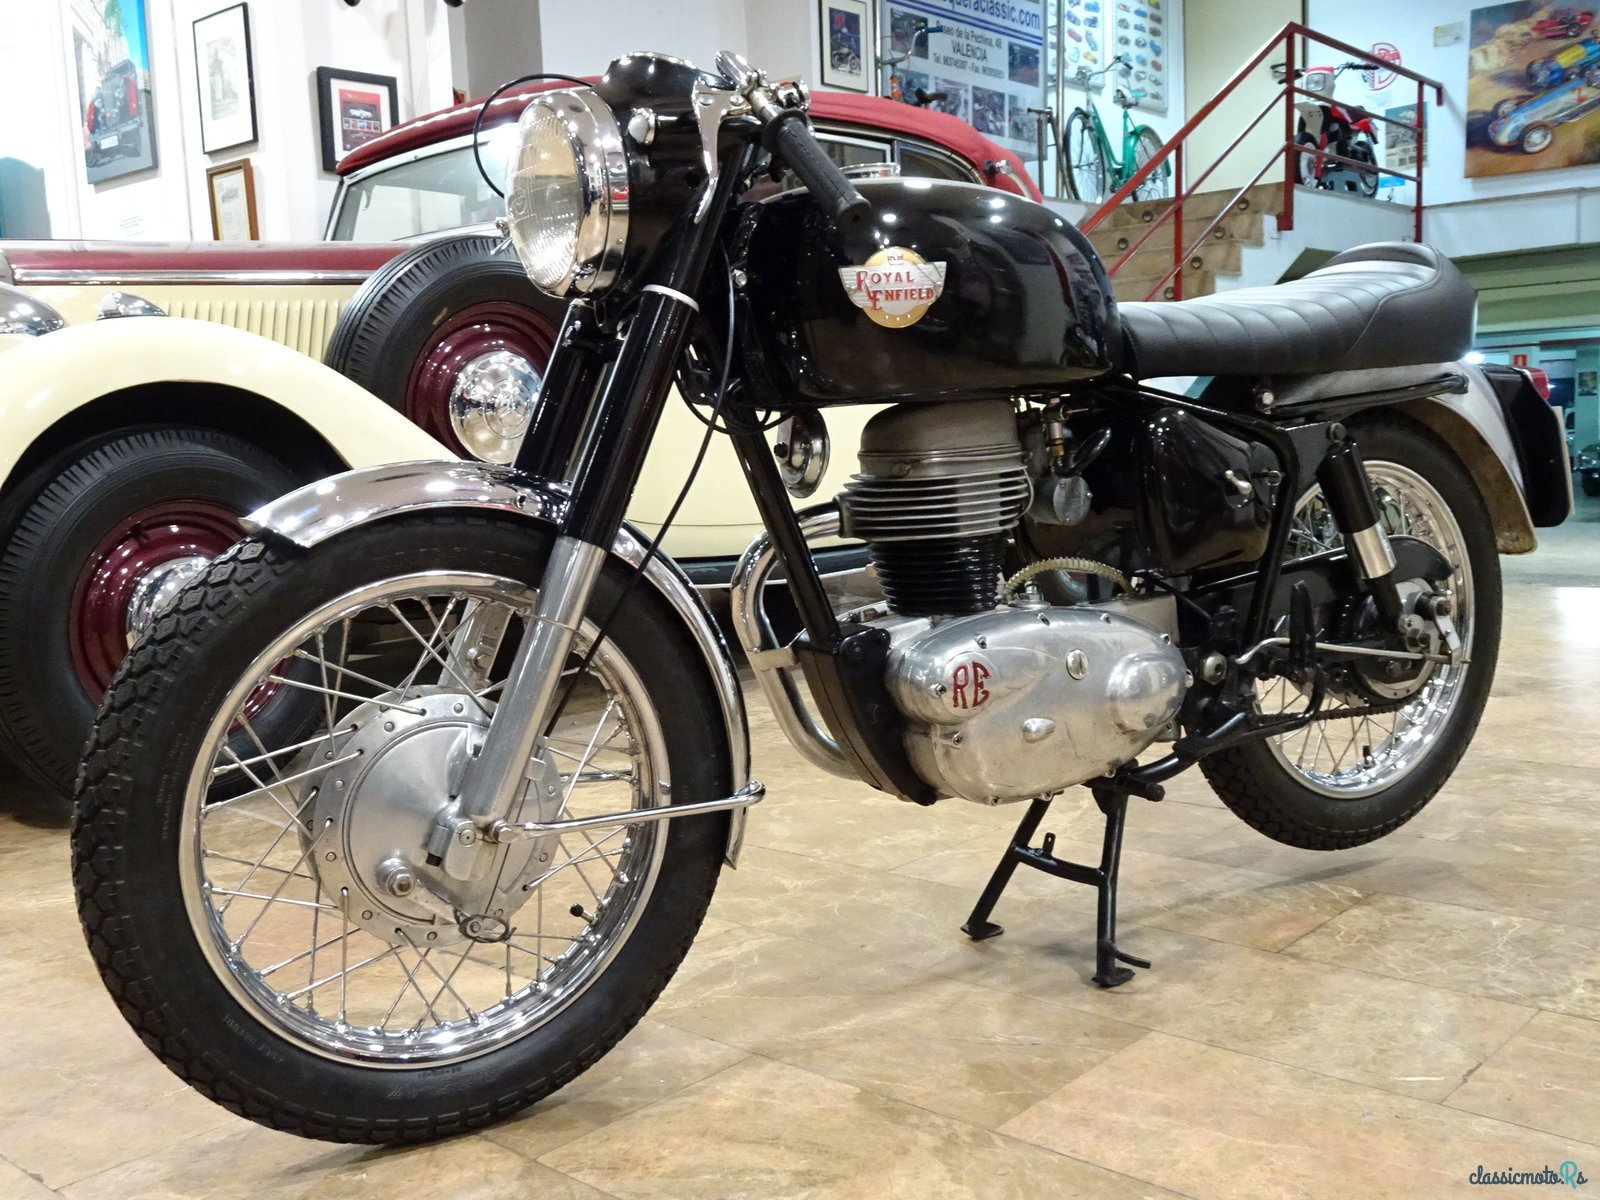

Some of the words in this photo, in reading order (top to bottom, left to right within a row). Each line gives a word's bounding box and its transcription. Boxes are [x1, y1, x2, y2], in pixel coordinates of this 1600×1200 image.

[951, 39, 988, 62] VALENCIA
[856, 271, 914, 295] ROYAL
[871, 287, 934, 311] ENFIELD
[952, 661, 990, 710] RE
